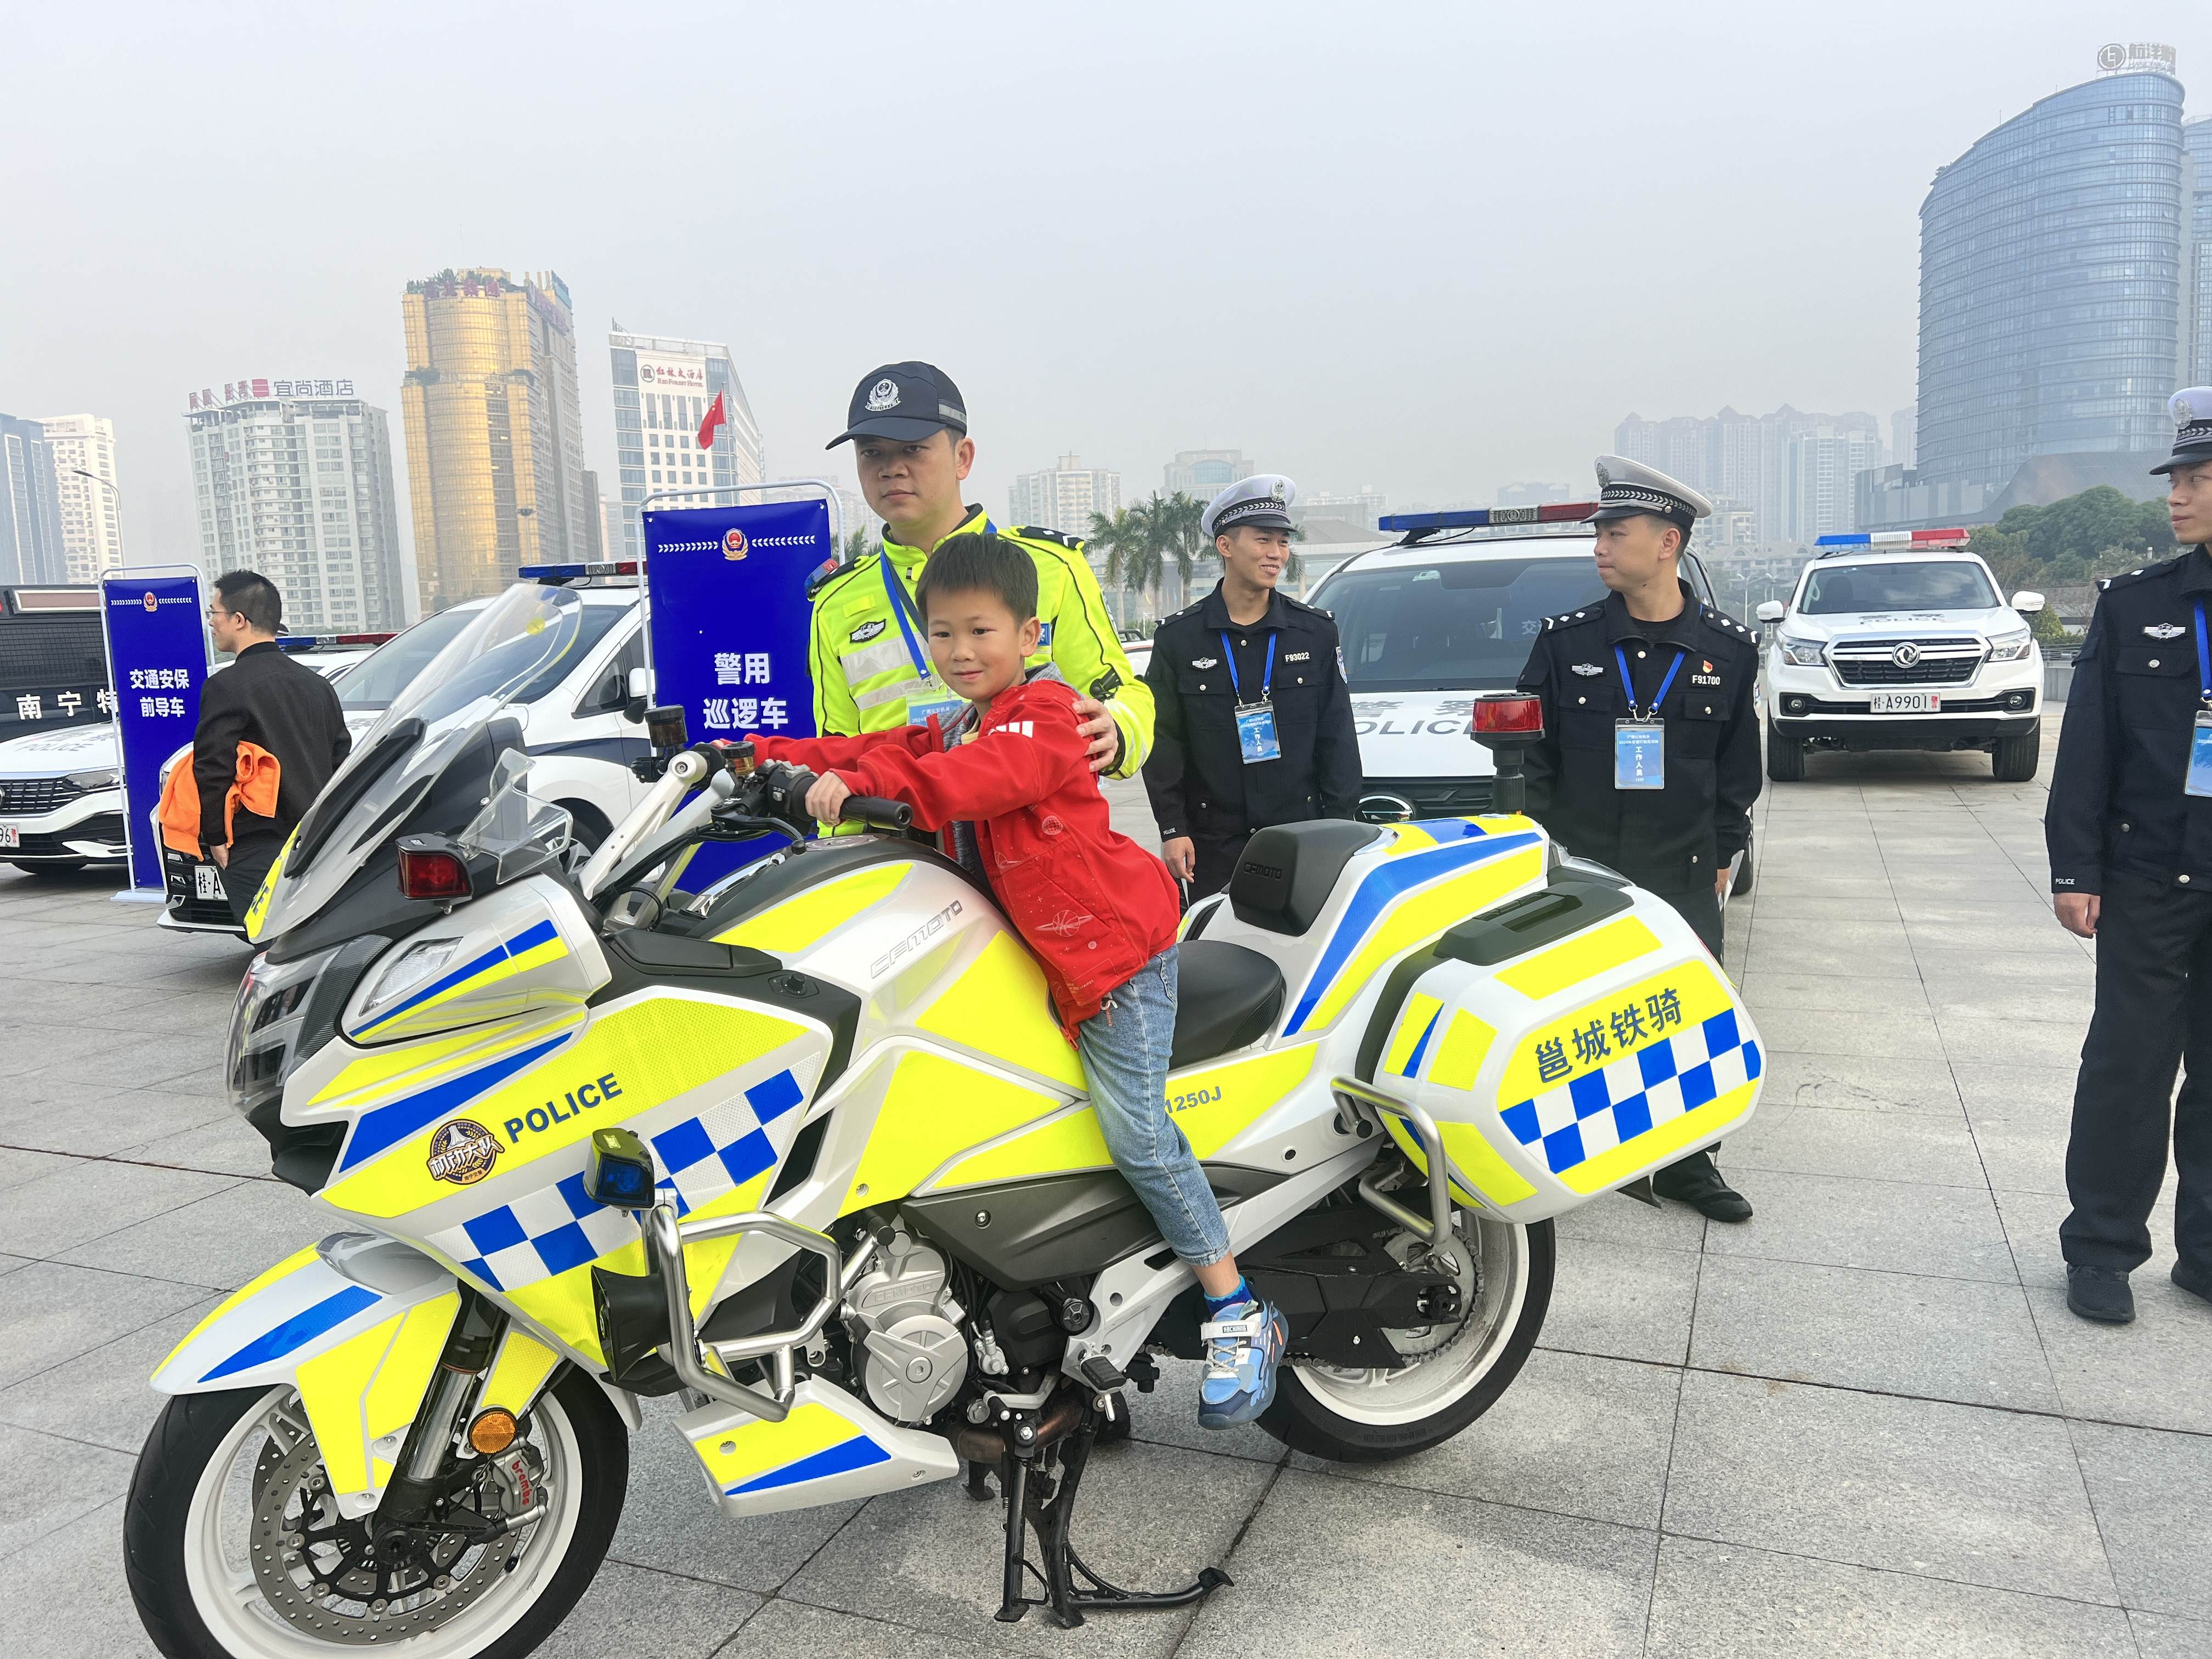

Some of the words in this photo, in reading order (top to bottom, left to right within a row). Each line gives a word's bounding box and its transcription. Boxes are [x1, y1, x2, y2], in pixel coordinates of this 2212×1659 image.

[274, 379, 354, 397] 宜尚酒店
[1522, 620, 1543, 635] 交
[714, 653, 770, 685] 警用
[1285, 652, 1310, 662] F93022
[129, 669, 189, 689] 交通安保
[1692, 675, 1720, 685] F91700
[140, 697, 185, 717] 前导车
[703, 697, 788, 729] 巡逻车
[1254, 727, 1262, 752] 工作人员
[1354, 720, 1474, 735] OLIC
[870, 900, 963, 979] CFMOTO
[1535, 988, 1682, 1084] 邕城铁骑
[504, 1072, 623, 1144] POLICE
[430, 1136, 498, 1177] 机动大队
[512, 1459, 532, 1505] brembo
